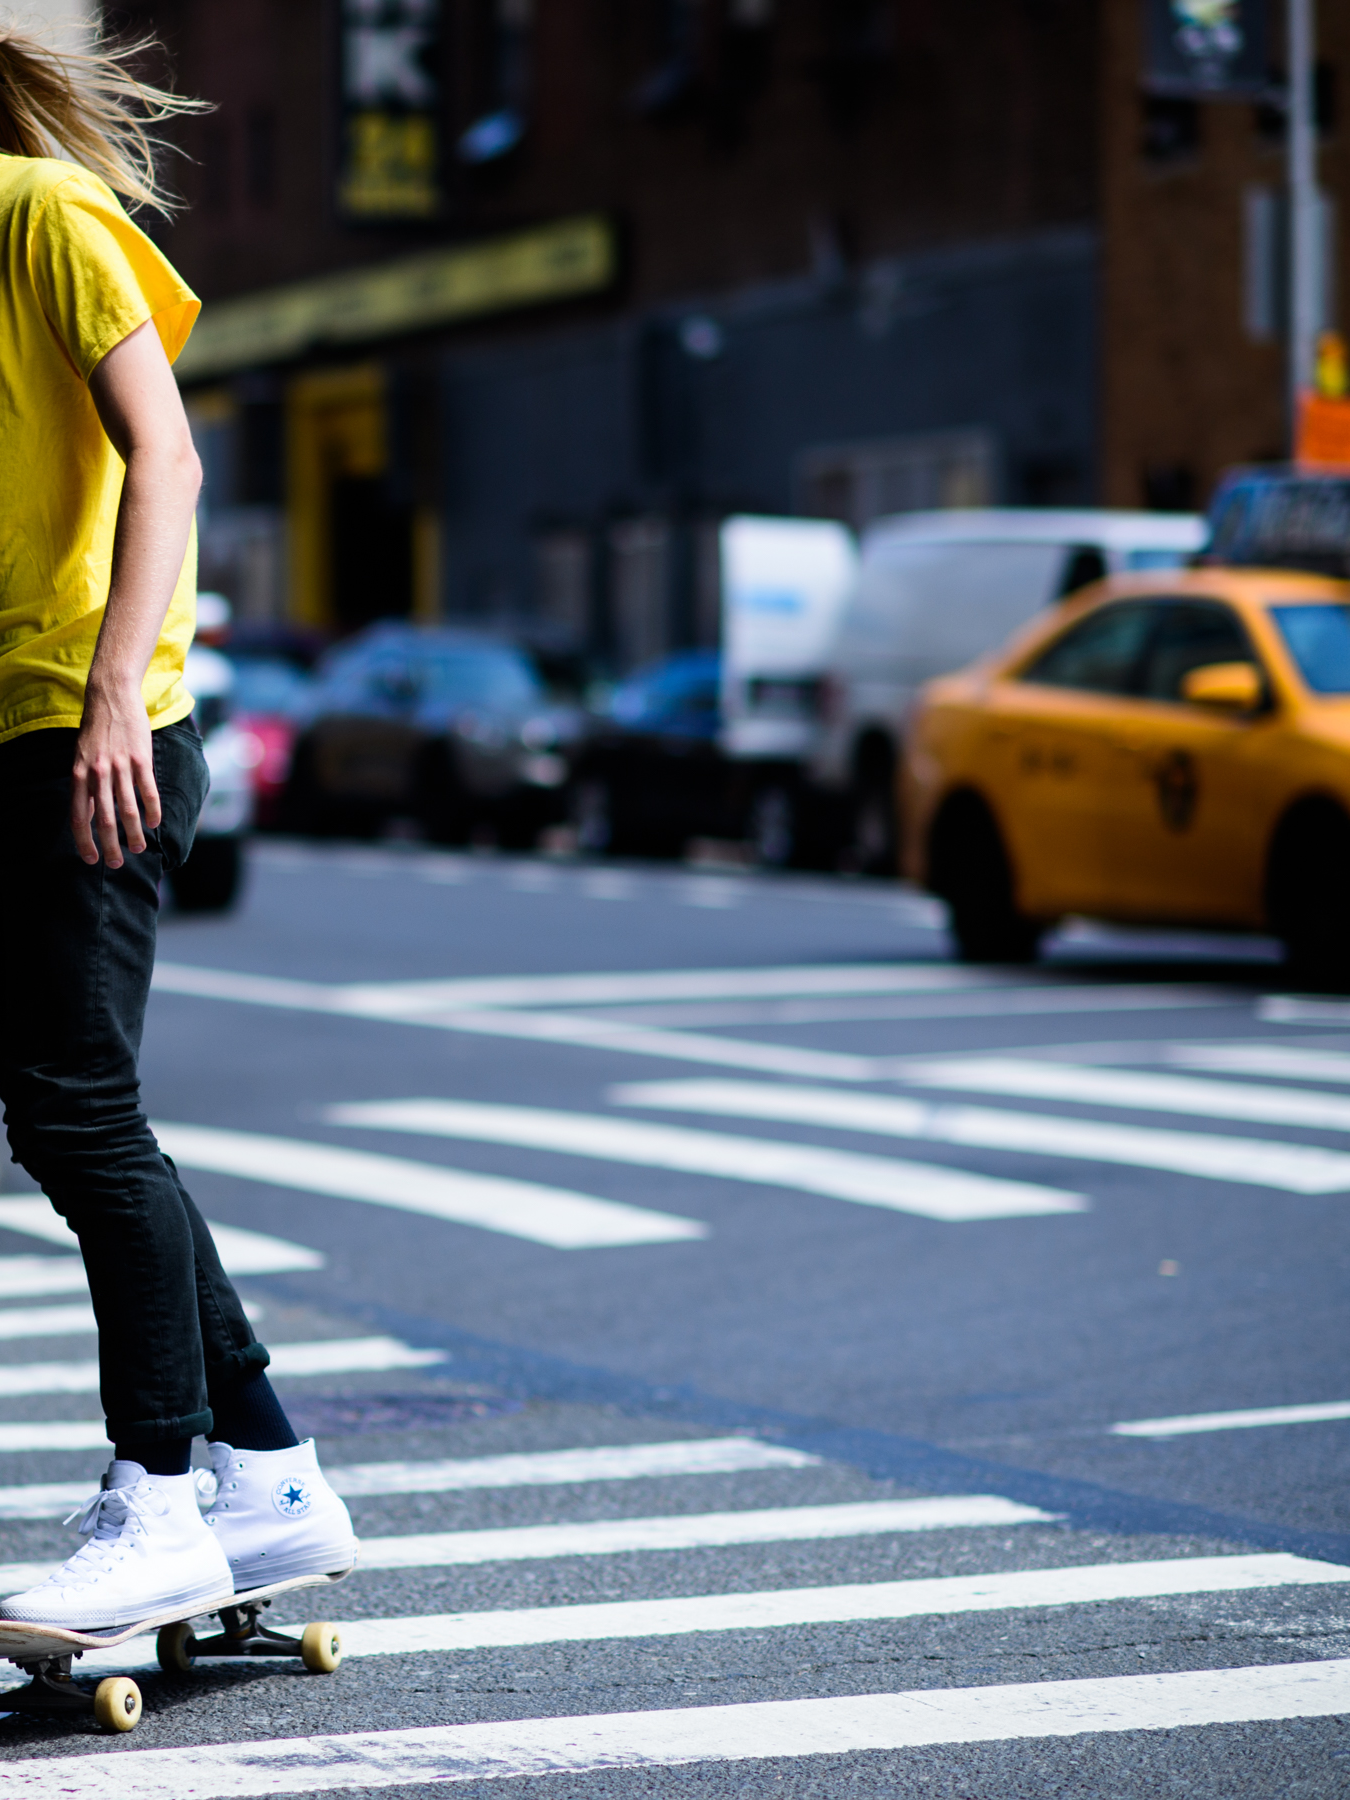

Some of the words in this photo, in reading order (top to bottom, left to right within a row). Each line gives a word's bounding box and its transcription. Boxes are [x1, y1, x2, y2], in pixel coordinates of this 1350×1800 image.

[276, 1477, 305, 1495] CONVERSE
[283, 1507, 296, 1515] ALL
[296, 1501, 311, 1515] STAR
